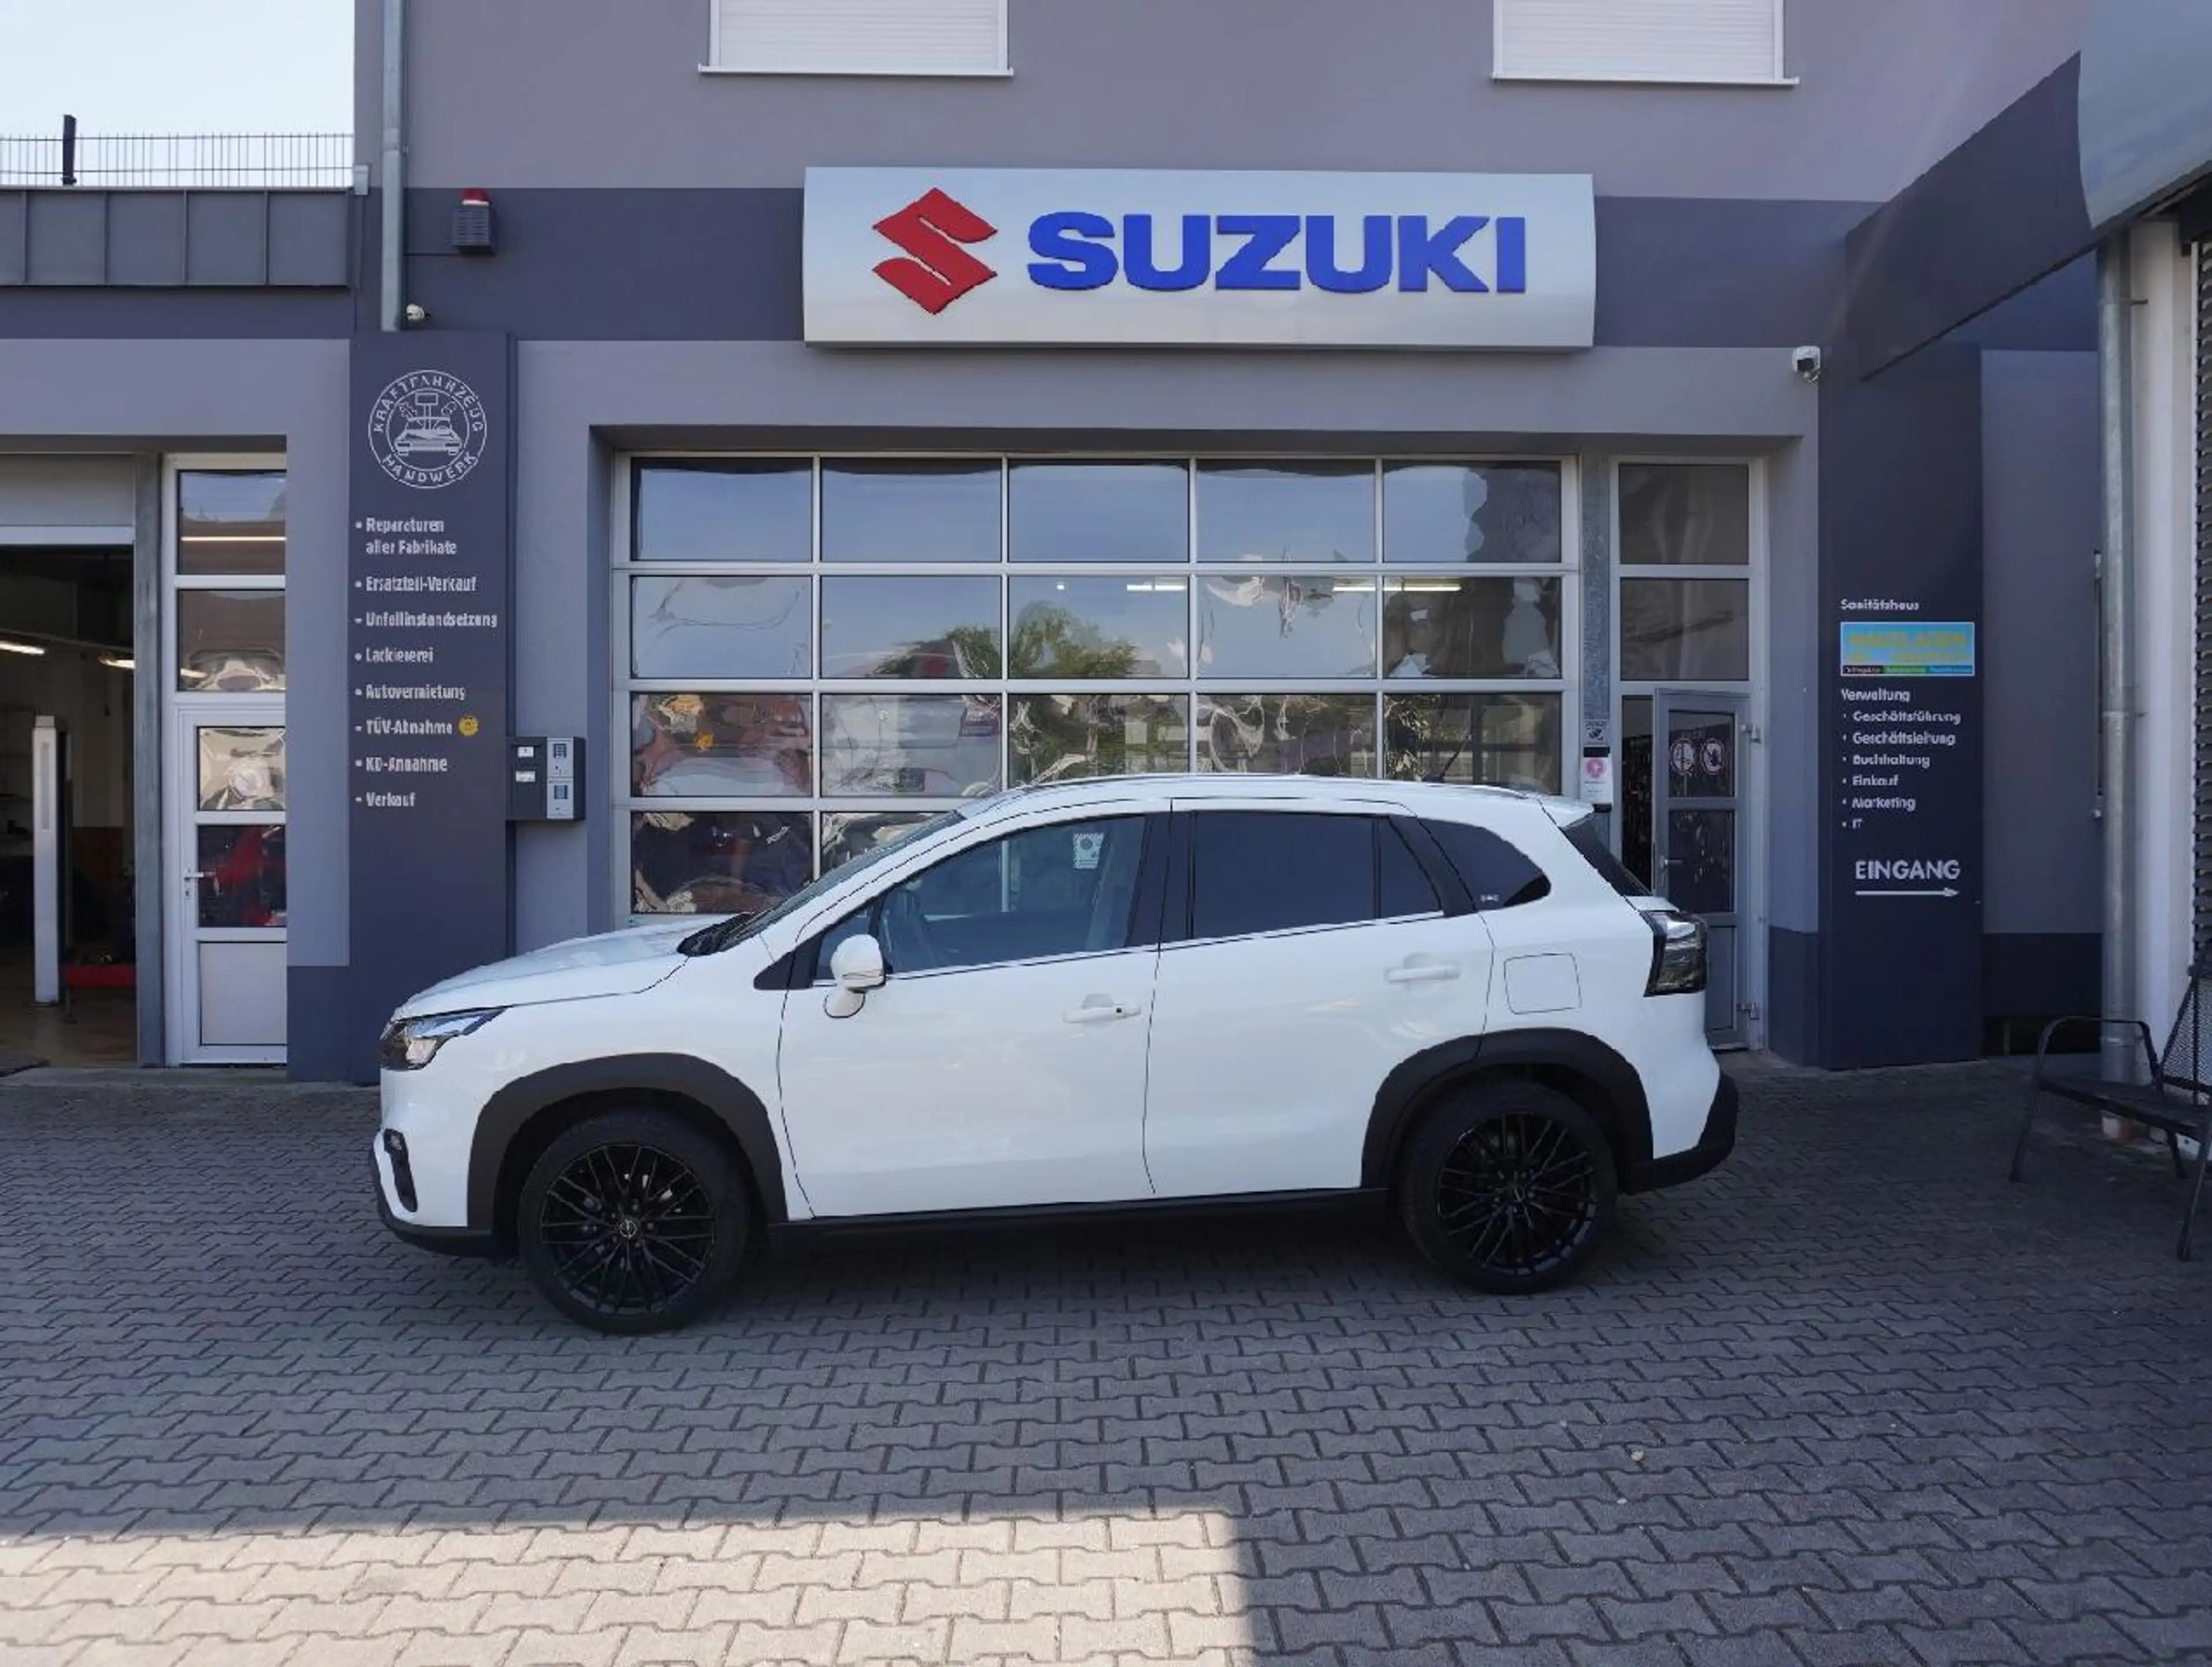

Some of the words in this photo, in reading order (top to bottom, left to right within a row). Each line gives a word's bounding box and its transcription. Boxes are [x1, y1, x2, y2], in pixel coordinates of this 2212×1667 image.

[1027, 211, 1526, 293] SUZUKI
[381, 451, 479, 483] HANDWERK
[366, 517, 444, 534] Reparaturen
[366, 540, 395, 555] aller
[399, 540, 457, 555] Fabrikate
[366, 577, 476, 592] Ersatzteil-Verkauf
[1840, 598, 1919, 611] Sanitätshaus
[366, 612, 497, 627] Unfallinstandsetzung
[366, 647, 433, 662] Lackiererei
[366, 684, 465, 700] Autovermietung
[1840, 688, 1911, 702] Verwaltung
[1853, 710, 1961, 725] Geschäftsführung
[366, 718, 453, 735] TÜV-Abnahme
[1853, 732, 1956, 746] Geschäftsleitung
[1853, 754, 1930, 768] Buchhaltung
[1852, 774, 1899, 785] Einkauf
[366, 792, 416, 807] Verkauf
[1852, 796, 1916, 812] Marketing
[1853, 818, 1862, 828] IT
[1855, 860, 1960, 879] EINGANG
